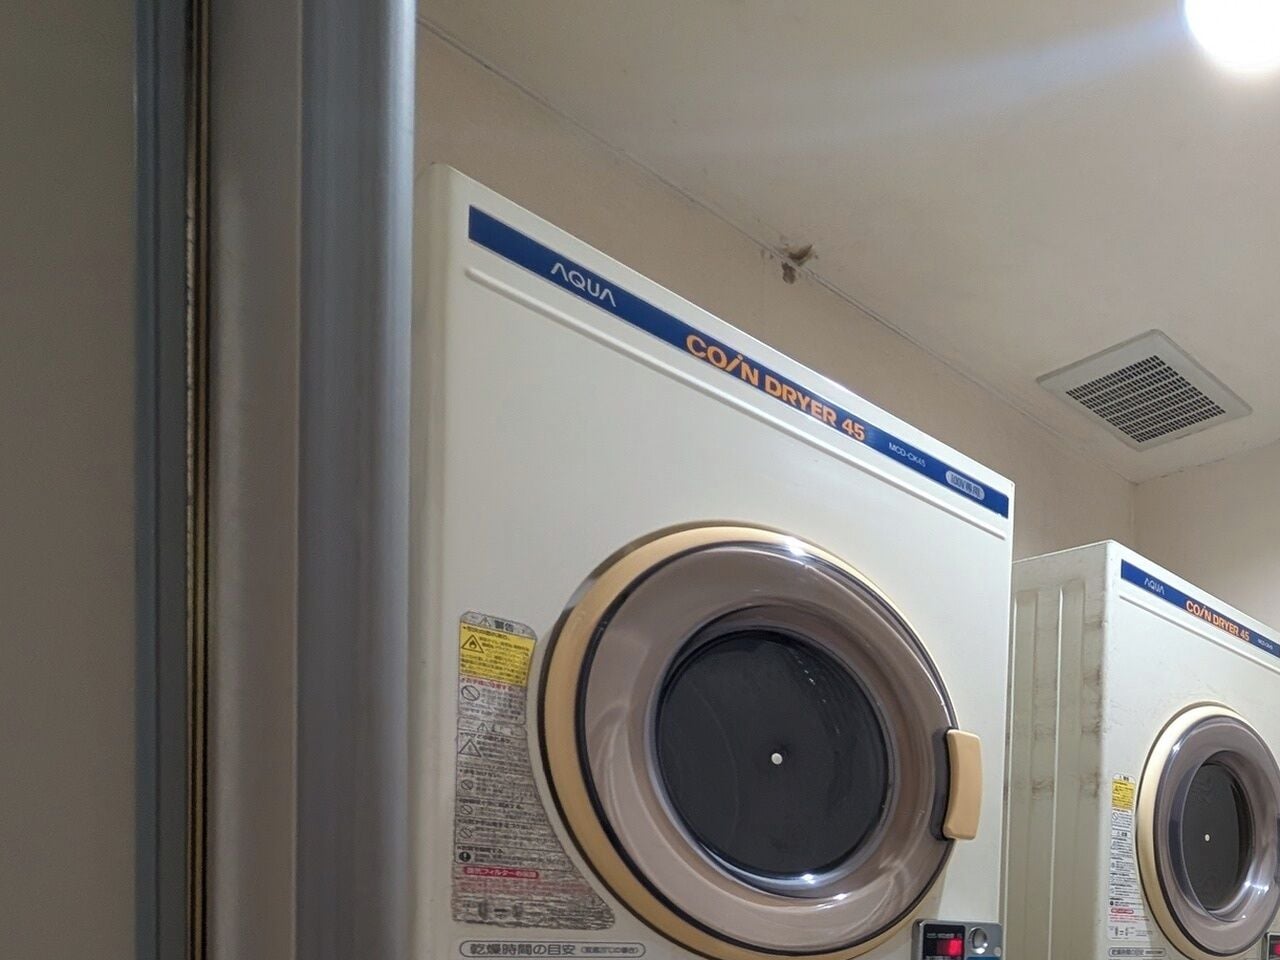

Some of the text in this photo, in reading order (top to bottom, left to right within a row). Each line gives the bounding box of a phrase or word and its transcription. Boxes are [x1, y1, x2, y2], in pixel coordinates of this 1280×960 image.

[551, 262, 617, 308] AQUA
[764, 374, 838, 428] DRYER
[842, 418, 866, 441] 45
[1144, 577, 1165, 596] AQUA
[1213, 614, 1239, 637] DRYER
[1240, 629, 1250, 642] 45
